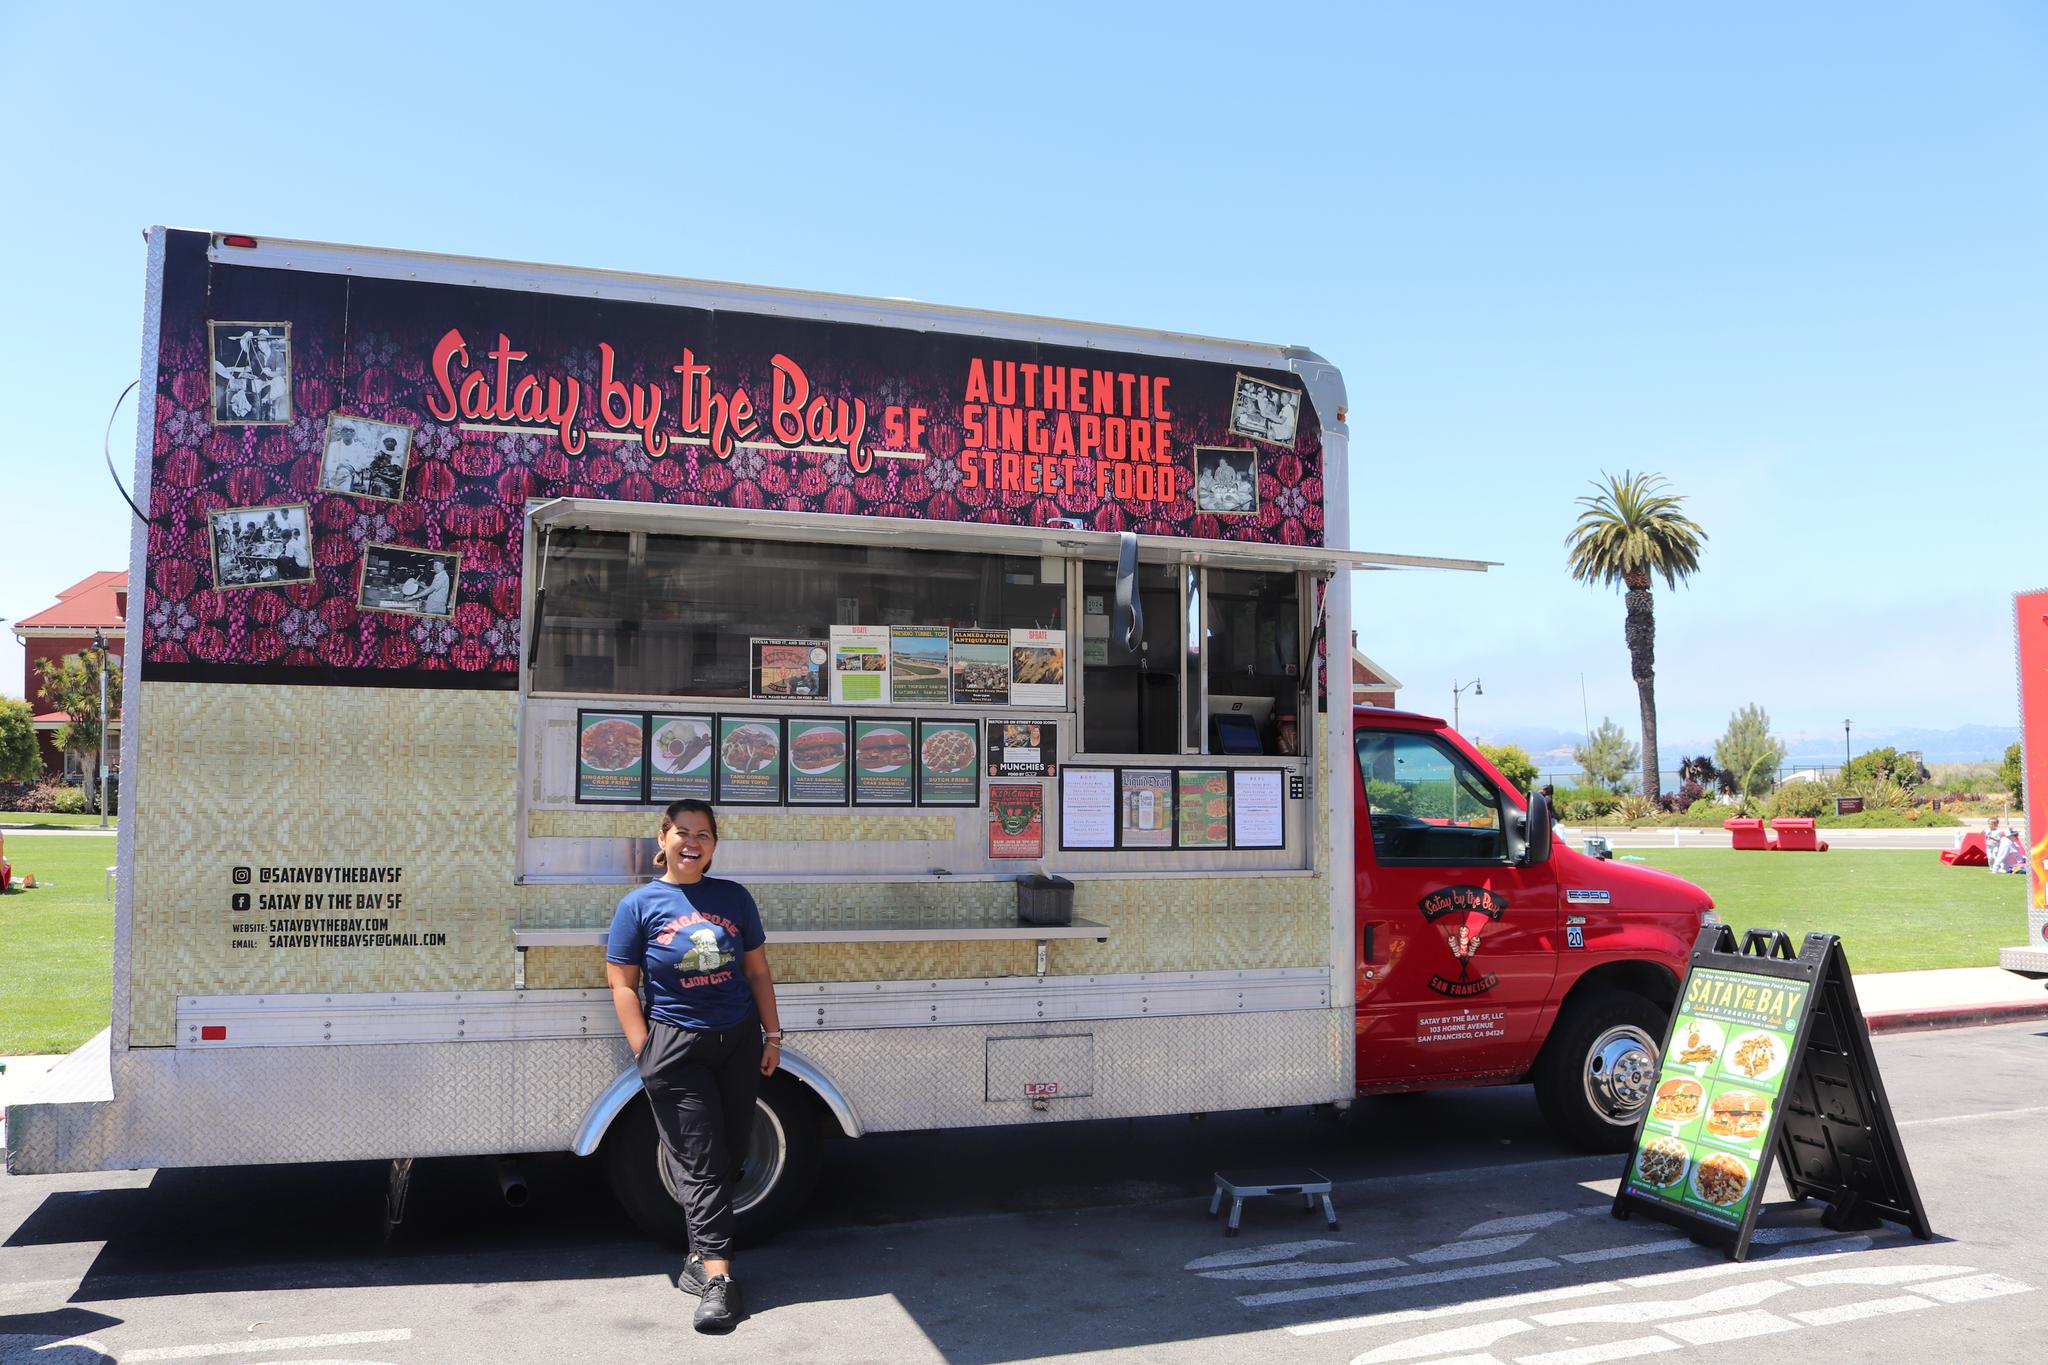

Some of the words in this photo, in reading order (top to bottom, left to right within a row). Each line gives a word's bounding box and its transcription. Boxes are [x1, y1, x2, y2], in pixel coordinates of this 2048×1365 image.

[964, 357, 1171, 420] AUTHENTIC
[427, 328, 585, 457] Satay
[600, 342, 668, 457] by
[673, 347, 760, 459] the
[771, 353, 873, 473] Bay
[885, 405, 927, 448] SF
[963, 404, 1173, 464] SINGAPORE
[961, 450, 1077, 495] STREET
[1095, 460, 1176, 503] FOOD
[1000, 763, 1045, 771] MUNCHIES
[1122, 775, 1148, 788] Liquid
[1148, 776, 1171, 787] Death
[260, 867, 402, 883] @SATAYBYTHEBAYSF
[259, 894, 301, 910] SATAY
[305, 894, 324, 909] BY
[328, 894, 352, 909] THE
[356, 894, 383, 909] BAY
[387, 894, 402, 909] SF
[1425, 896, 1453, 915] Satay
[1452, 889, 1466, 908] by
[1466, 889, 1480, 909] the
[1482, 892, 1500, 919] Bay
[232, 924, 268, 933] WEBSITE:
[269, 918, 388, 932] SATAYBYTHEBAY.COM
[656, 912, 739, 945] SINGAPORE
[232, 940, 257, 949] EMAIL:
[269, 933, 446, 948] SATAYBYTHEBAYSF@GMAIL.COM
[1569, 932, 1582, 946] 20
[680, 976, 709, 989] LION
[710, 970, 733, 985] CITY
[1431, 977, 1448, 992] SAN
[1450, 975, 1496, 995] FRANCISCO
[1688, 978, 1747, 1008] SATAY
[1746, 988, 1758, 998] BY
[1742, 998, 1756, 1010] THE
[1756, 988, 1801, 1018] BAY
[1420, 1017, 1440, 1025] SATAY
[1723, 1008, 1768, 1021] FRANCISCO
[1467, 1022, 1494, 1030] AVENUE
[1433, 1032, 1473, 1041] FRANCISCO,
[1026, 1083, 1057, 1093] LPG
